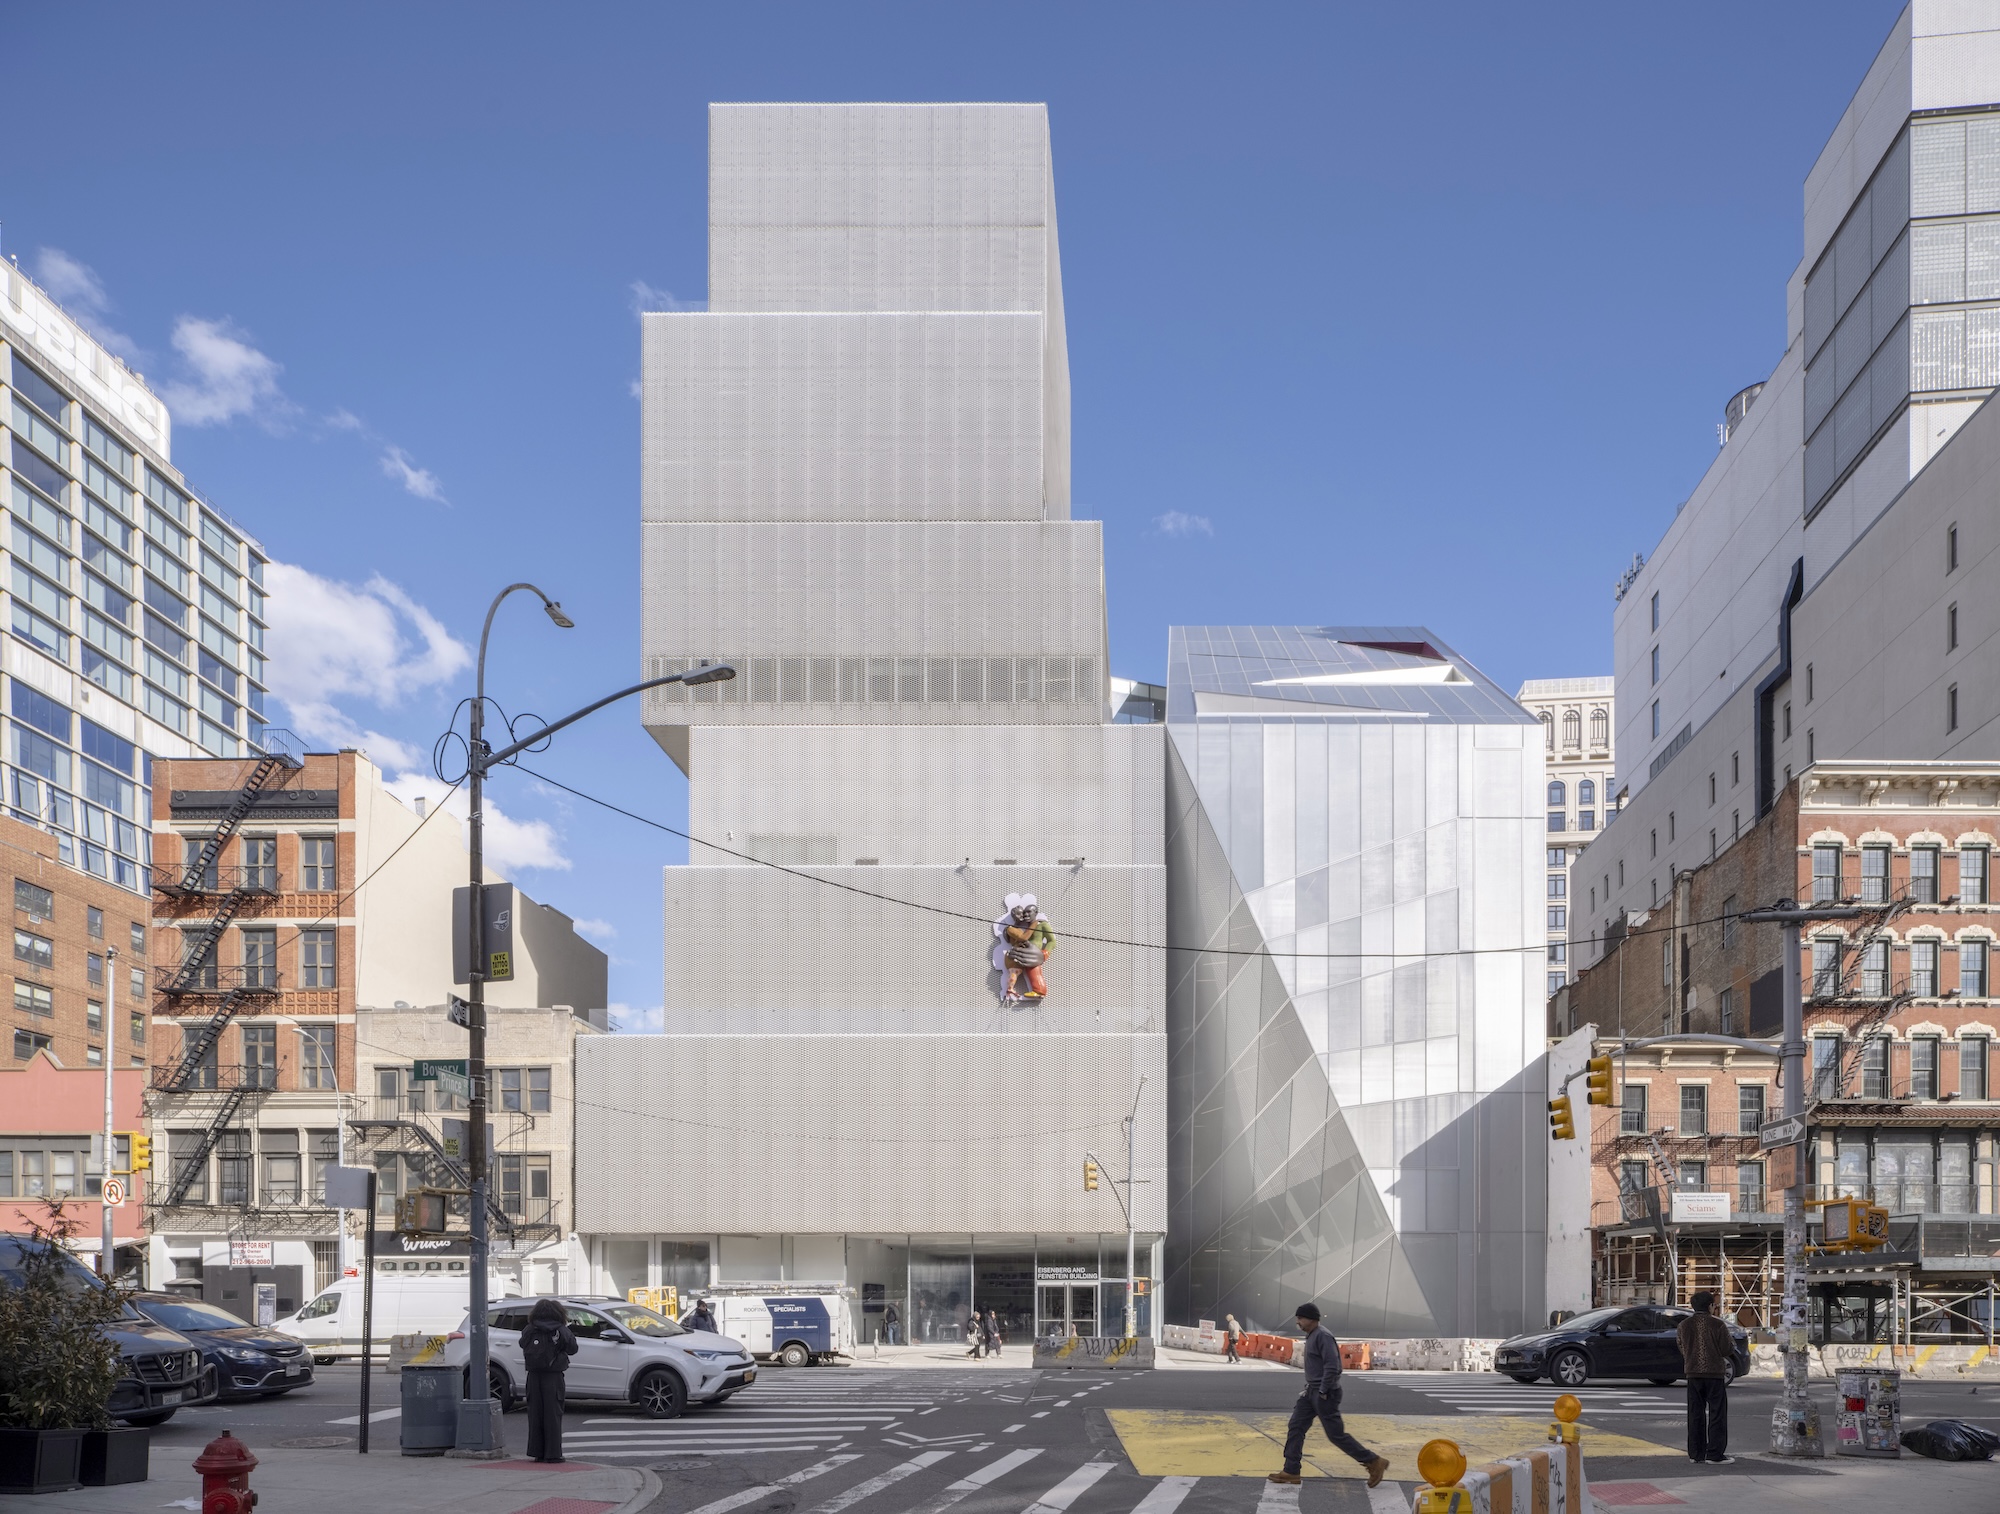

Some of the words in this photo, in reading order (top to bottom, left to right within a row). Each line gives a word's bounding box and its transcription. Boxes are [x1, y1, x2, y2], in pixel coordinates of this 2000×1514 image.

[493, 953, 506, 961] NYC
[492, 960, 508, 968] TATTOO
[493, 968, 508, 976] SHOP
[454, 1005, 466, 1020] ONE
[441, 1073, 462, 1094] Prince
[1764, 1129, 1777, 1142] ONE
[1782, 1123, 1797, 1137] WAY
[1686, 1204, 1716, 1212] Sciame
